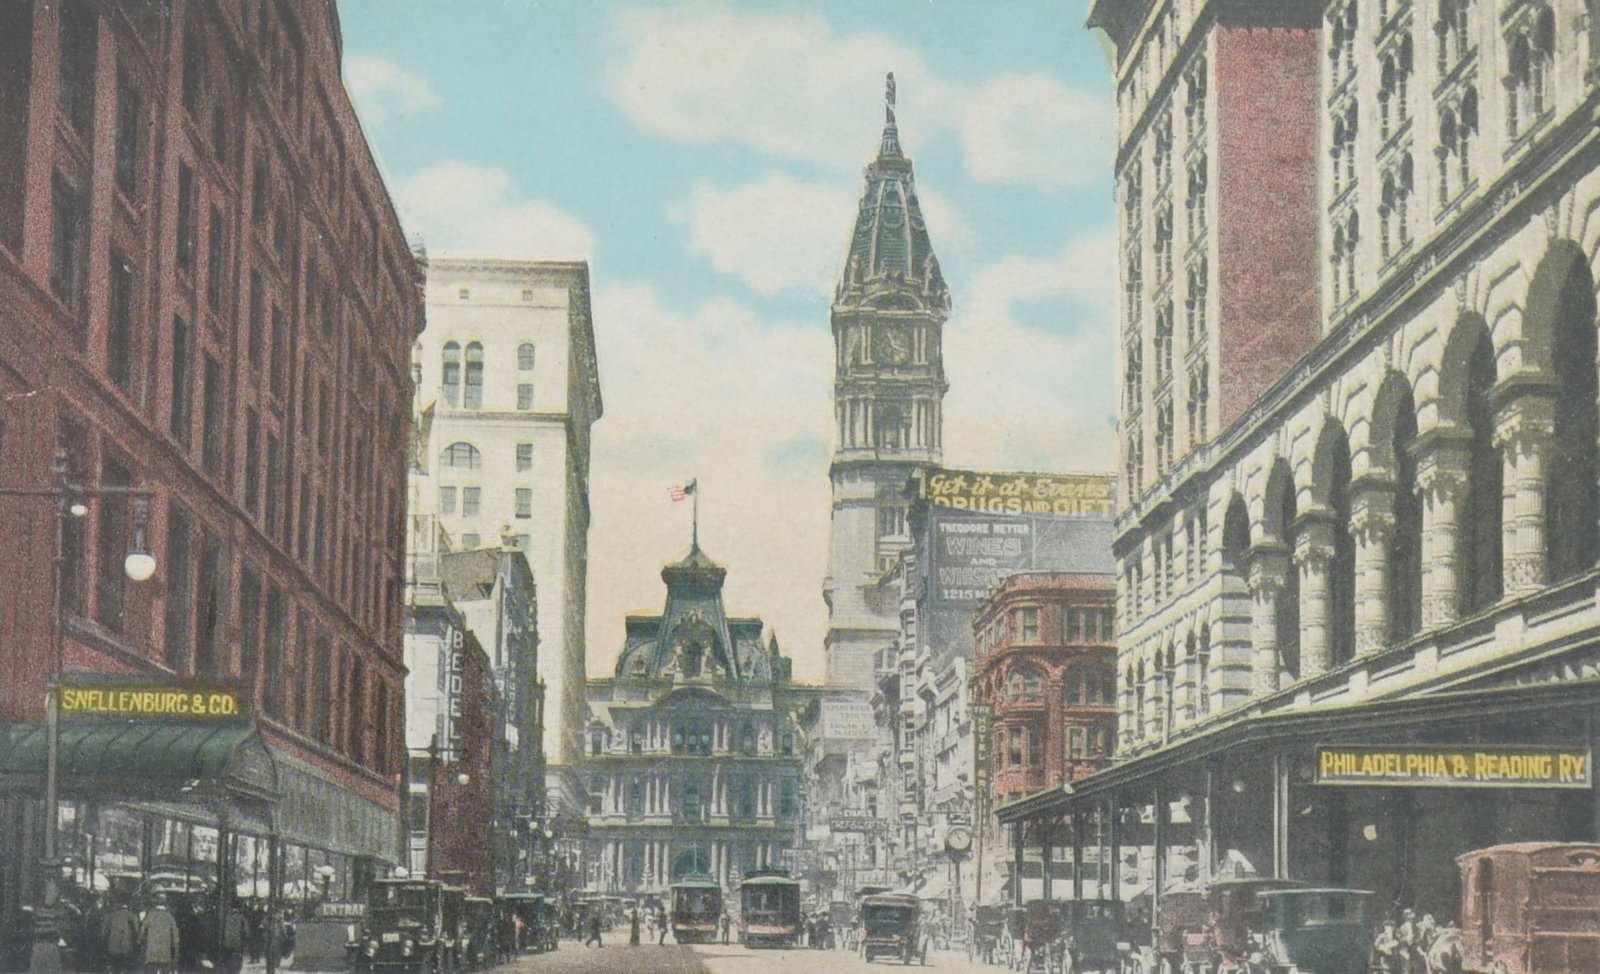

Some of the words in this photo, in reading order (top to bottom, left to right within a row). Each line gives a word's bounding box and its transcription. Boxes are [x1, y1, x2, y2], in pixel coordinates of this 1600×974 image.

[930, 474, 966, 496] Get
[972, 475, 994, 496] it
[999, 476, 1030, 497] at
[934, 497, 1022, 515] DRUGS
[939, 523, 989, 534] THEODORE
[946, 536, 1022, 556] WINES
[970, 558, 997, 566] AND
[943, 589, 974, 599] 1215
[62, 690, 188, 713] SNELLENBURG
[191, 694, 206, 714] &
[209, 694, 239, 715] CO.
[449, 630, 463, 761] BEDELL
[1321, 751, 1447, 777] PHILADELPHIA
[1452, 754, 1469, 777] &
[1475, 752, 1551, 780] READING
